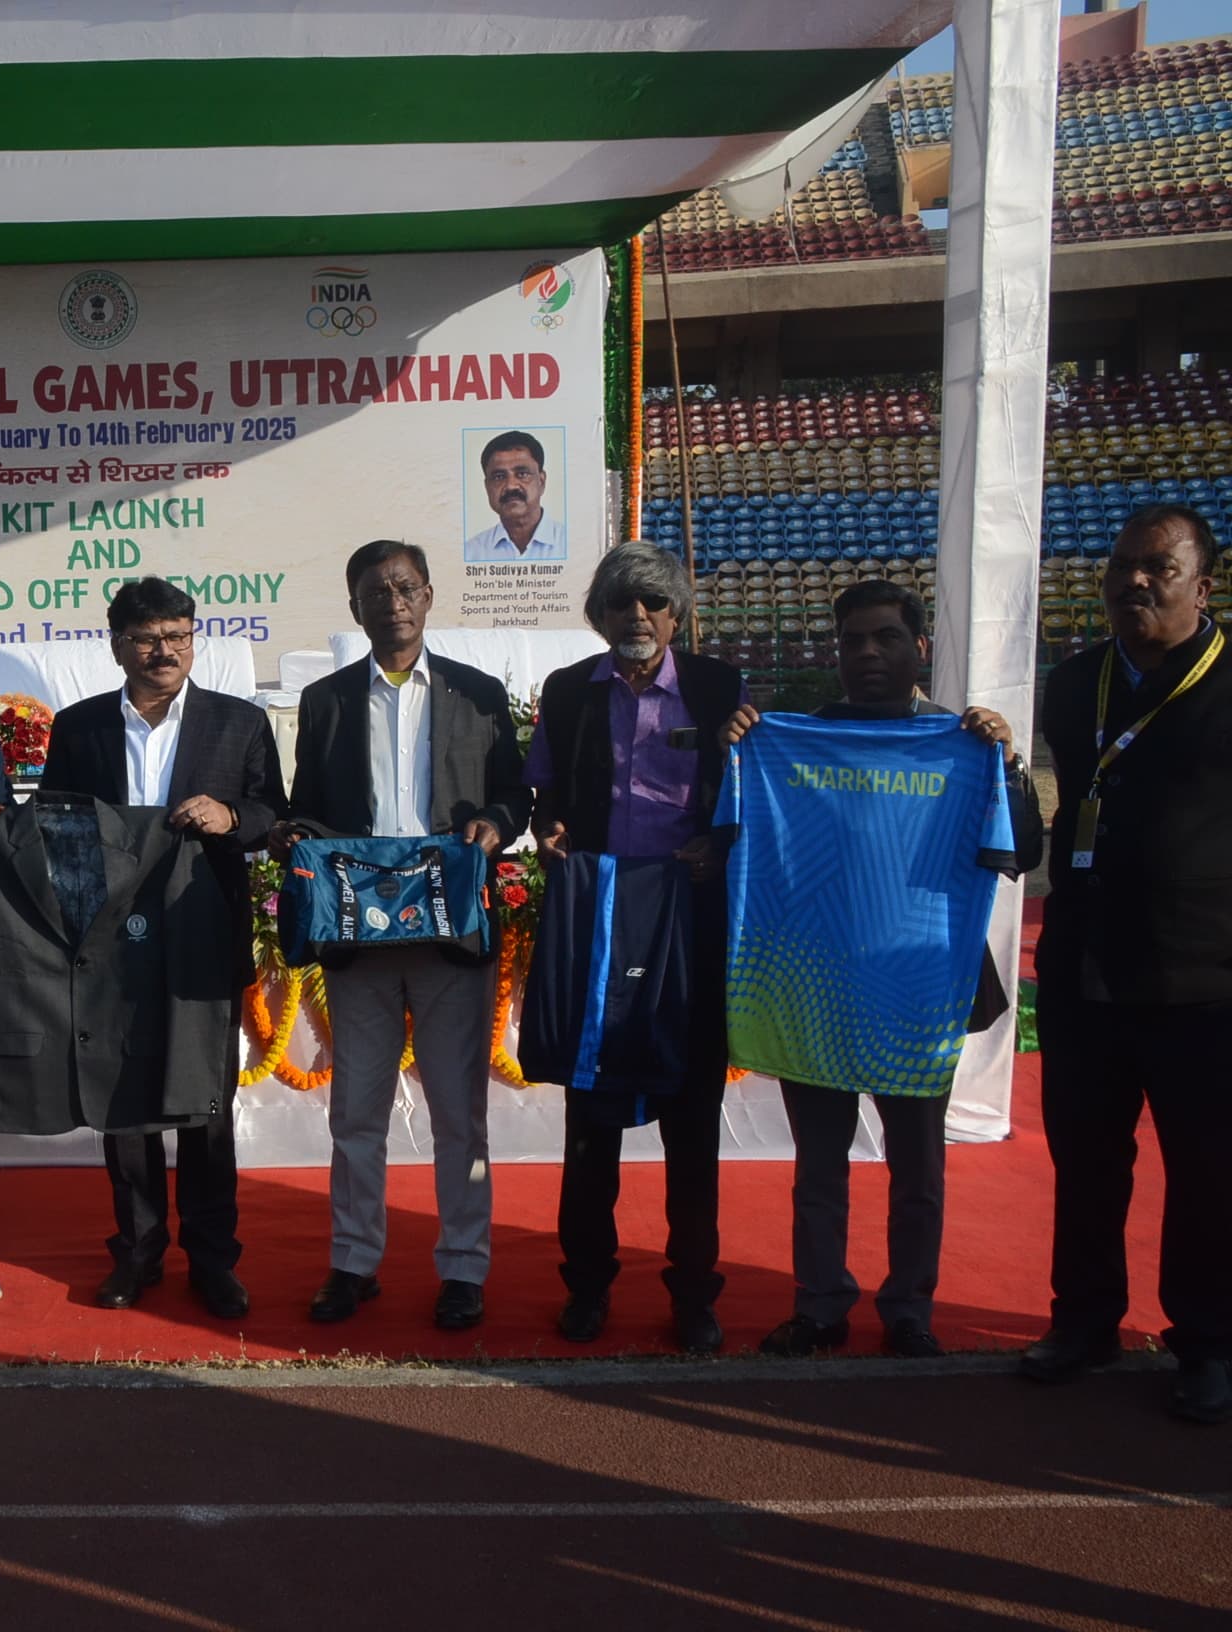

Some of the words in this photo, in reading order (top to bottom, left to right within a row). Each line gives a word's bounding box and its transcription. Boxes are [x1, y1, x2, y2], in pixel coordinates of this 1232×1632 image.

[312, 284, 371, 303] INDIA
[33, 361, 213, 415] GAMES,
[230, 352, 561, 408] UTTRAKHAND
[57, 423, 81, 447] To
[86, 422, 130, 446] 14th
[136, 420, 235, 445] February
[241, 417, 297, 441] 2025
[67, 459, 91, 484] से
[98, 457, 177, 482] शिखर
[182, 462, 232, 480] तक
[1, 502, 55, 533] KIT
[69, 497, 205, 532] LAUNCH
[67, 537, 141, 571] AND
[465, 565, 487, 577] Shri
[489, 564, 528, 577] Sudivya
[531, 564, 564, 575] Kumar
[516, 579, 557, 588] Minister
[28, 578, 89, 610] OFF
[102, 572, 285, 606] CMONY
[462, 592, 518, 604] Department
[520, 591, 530, 600] of
[531, 591, 569, 600] Tourism
[460, 606, 490, 617] Sports
[492, 604, 510, 614] and
[512, 604, 539, 613] Youth
[541, 603, 571, 613] Affairs
[493, 617, 539, 628] Jharkhand
[787, 762, 946, 797] JHARKHAND
[341, 914, 355, 941] ALIVE
[432, 897, 452, 938] INSPIRED
